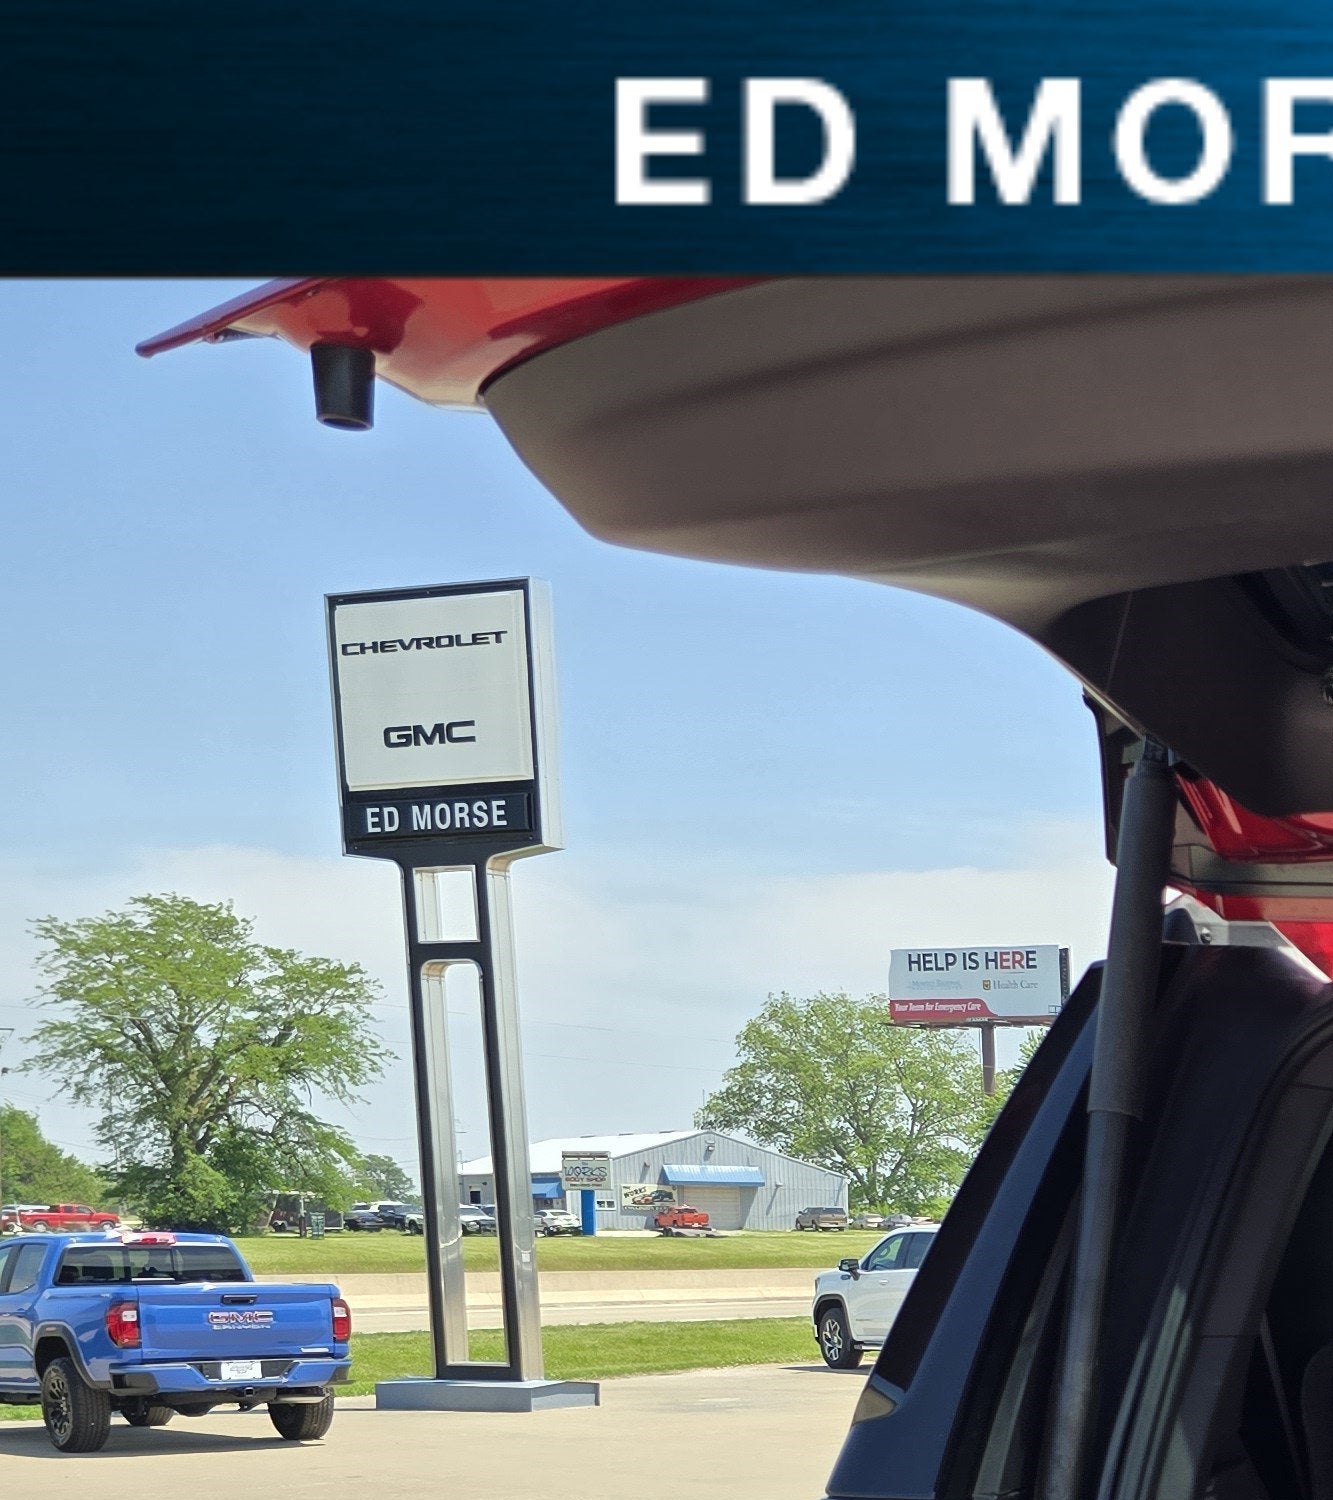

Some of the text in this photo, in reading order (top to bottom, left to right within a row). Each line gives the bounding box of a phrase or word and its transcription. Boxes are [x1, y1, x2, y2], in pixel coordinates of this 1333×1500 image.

[341, 630, 508, 656] CHEVROLET
[383, 720, 477, 749] GMC
[366, 800, 508, 834] ED MORSE
[908, 950, 1038, 972] HELP IS HERE
[993, 979, 1039, 990] Health Care
[208, 1311, 274, 1324] GMC
